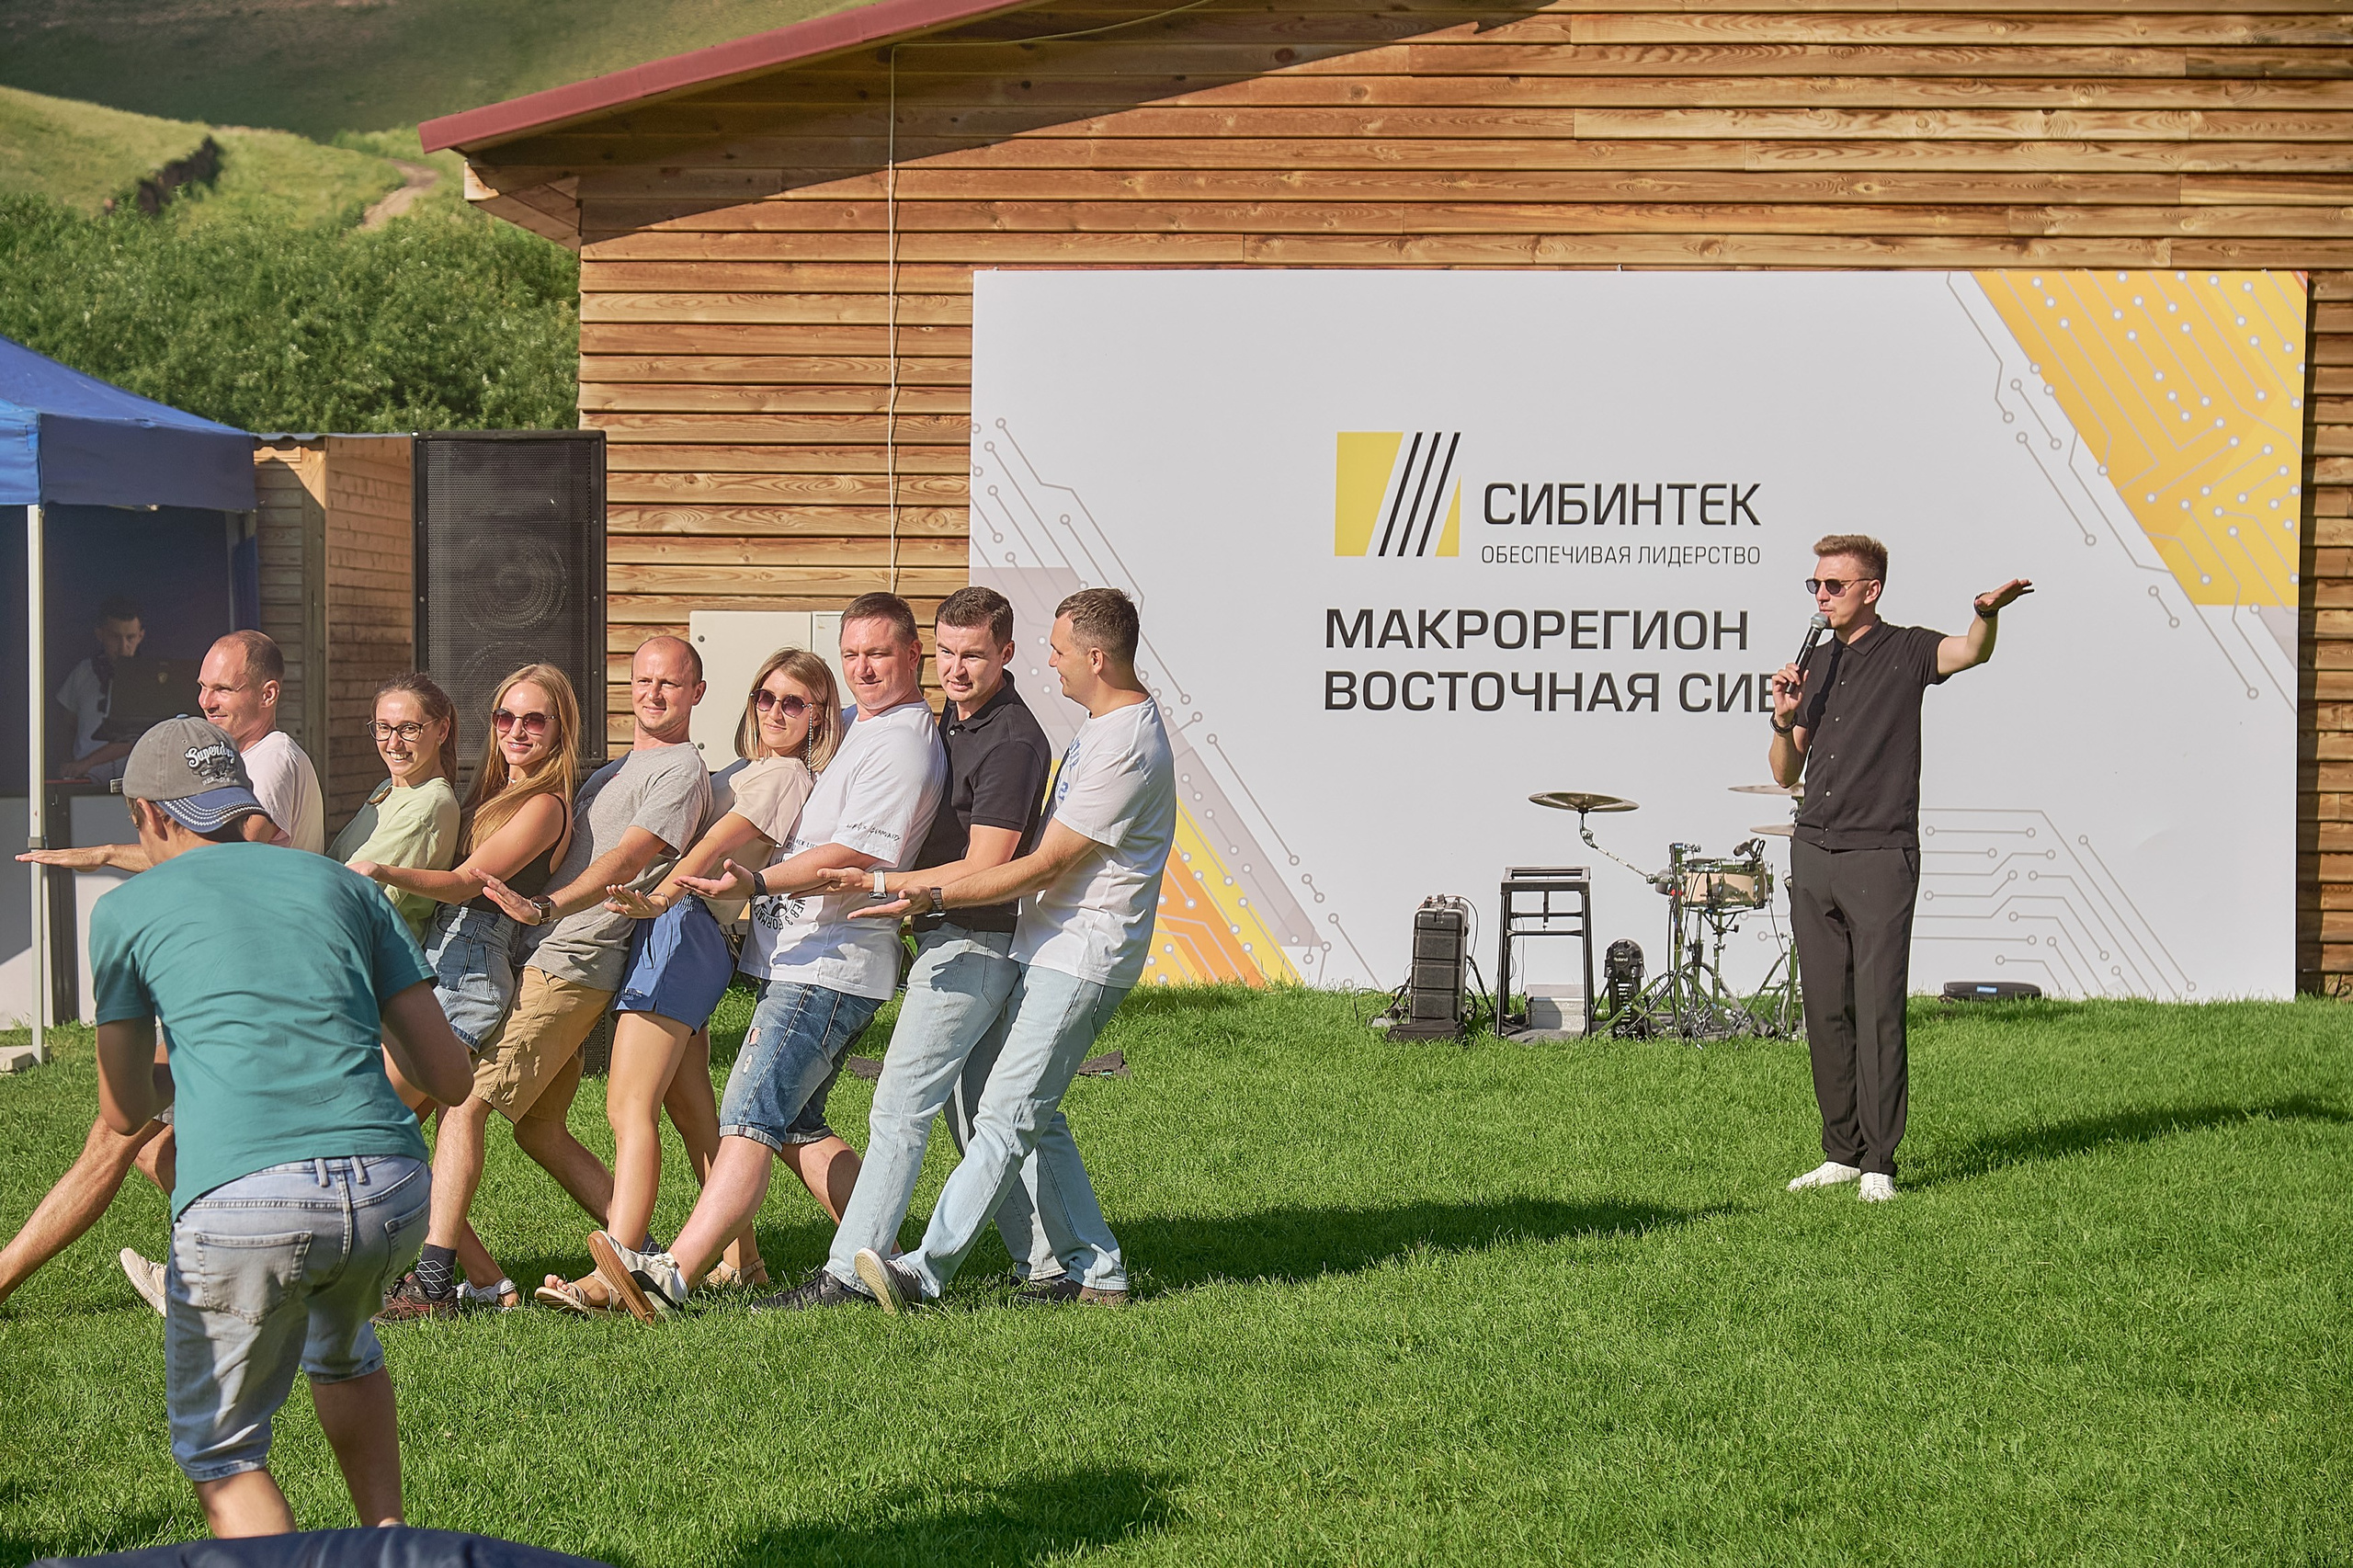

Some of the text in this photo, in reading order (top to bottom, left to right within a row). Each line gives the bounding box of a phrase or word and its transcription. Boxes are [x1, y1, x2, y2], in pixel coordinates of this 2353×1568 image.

[1483, 483, 1762, 526] СИБИНТЕК
[1481, 545, 1761, 568] ОБЕСПЕЧИВАЯ ЛИДЕРСТВО
[1324, 608, 1748, 651] МАКРОРЕГИОН
[1324, 670, 1776, 713] ВОСТОЧНАЯ СИБ
